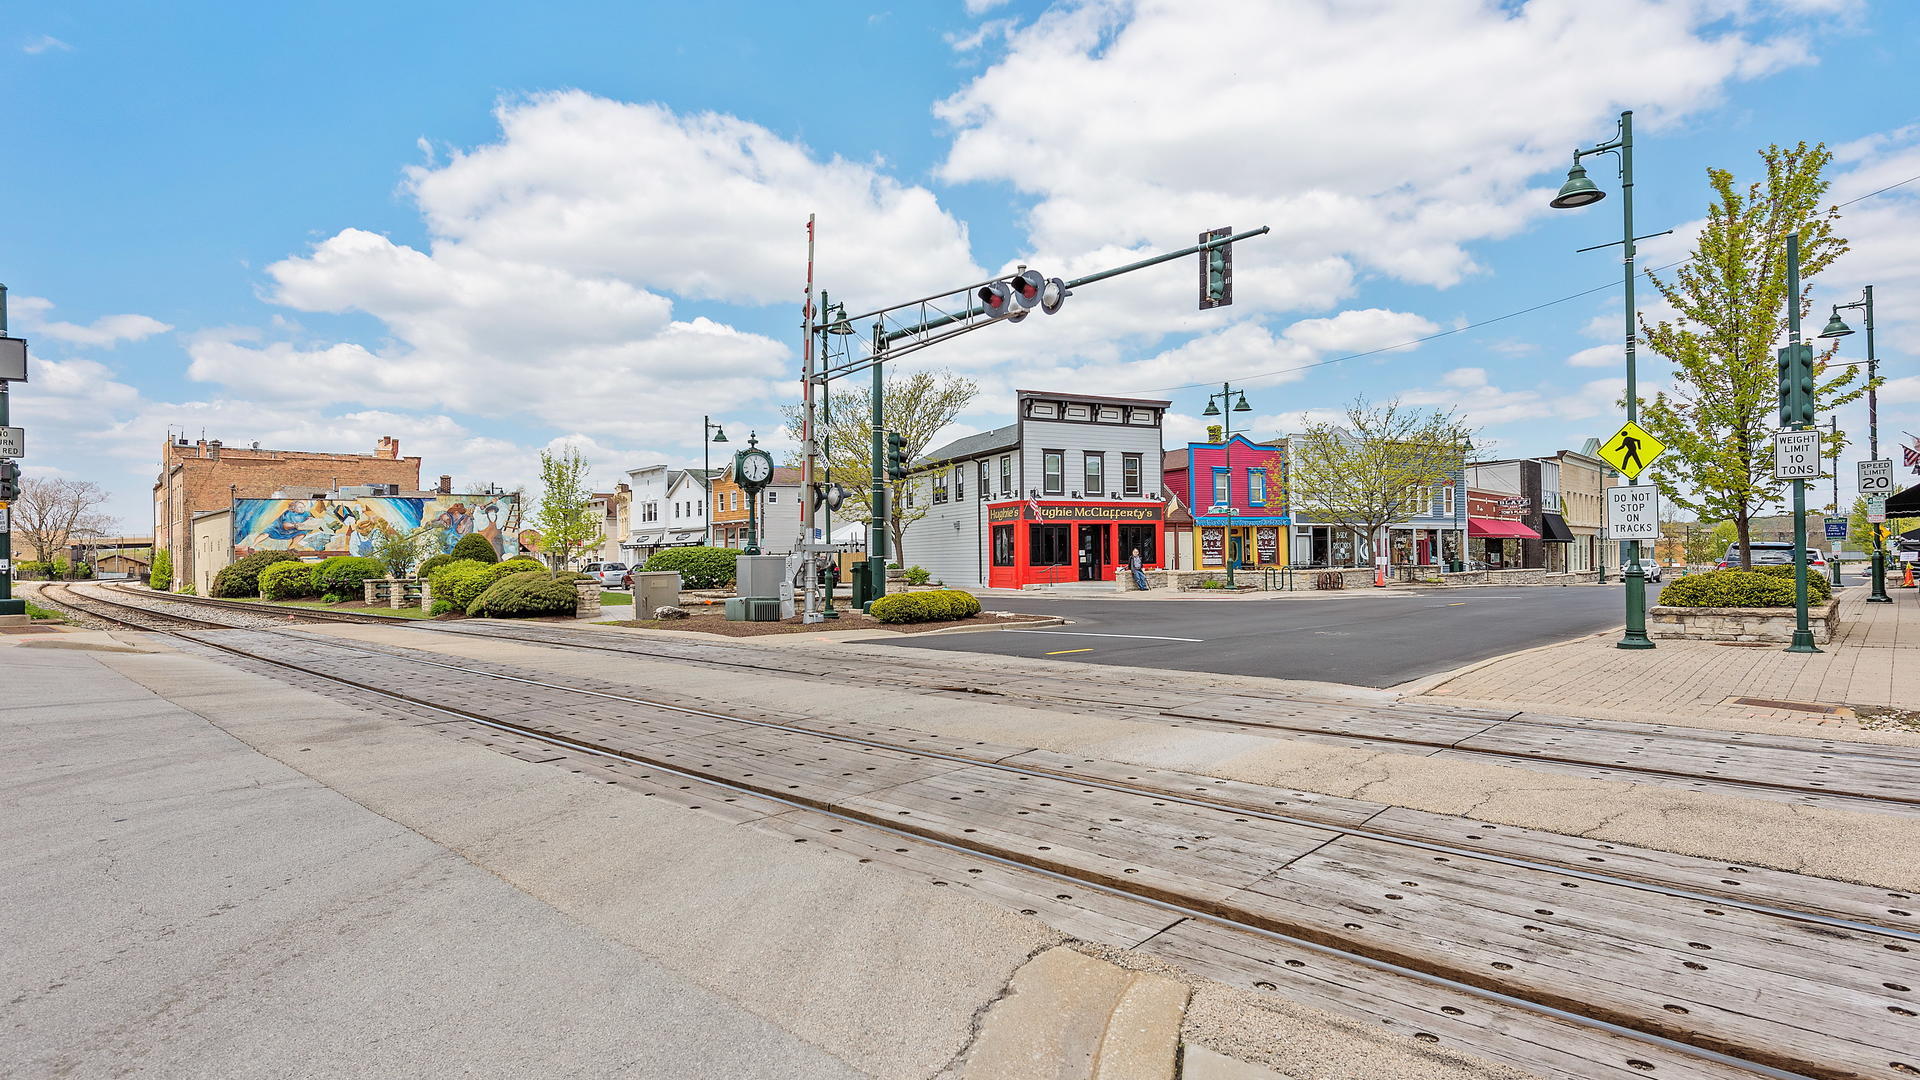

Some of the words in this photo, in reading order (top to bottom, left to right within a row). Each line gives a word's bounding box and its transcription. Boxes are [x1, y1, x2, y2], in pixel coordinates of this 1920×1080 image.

[1779, 435, 1816, 444] WEIGHT
[1784, 444, 1810, 453] LIMIT
[1790, 454, 1804, 463] 10
[1781, 465, 1814, 475] TONS
[1860, 462, 1890, 470] SPEED
[1862, 476, 1889, 489] 20
[1614, 494, 1627, 503] DO
[1631, 492, 1651, 502] NOT
[1620, 503, 1645, 513] STOP
[989, 506, 1019, 521] Hughie's
[1074, 507, 1153, 520] McClafferty's
[1626, 513, 1640, 523] ON
[1614, 523, 1653, 533] TRACKS
